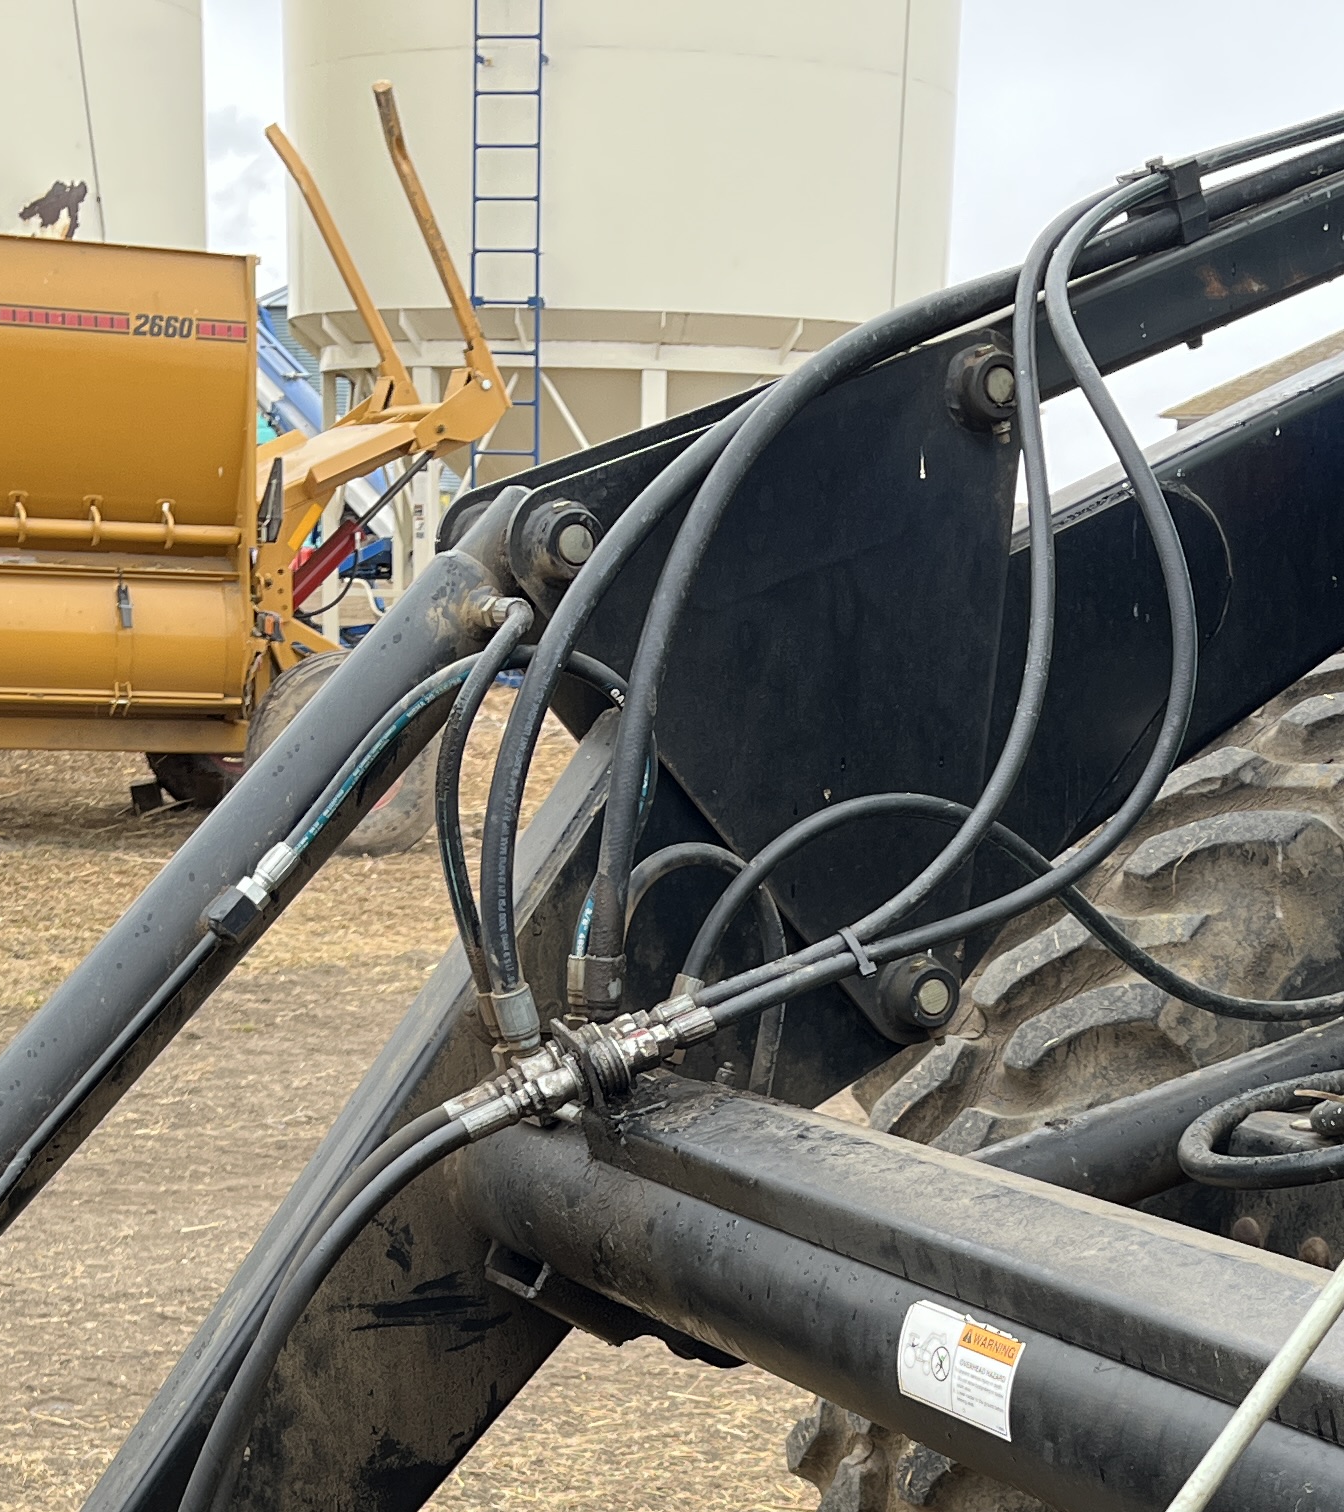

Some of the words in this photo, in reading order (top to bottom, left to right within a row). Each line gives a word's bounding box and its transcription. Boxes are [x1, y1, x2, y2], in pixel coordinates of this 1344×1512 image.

[133, 313, 193, 339] 2660
[500, 837, 509, 854] MAX
[498, 898, 506, 911] PSI
[973, 1333, 1016, 1359] WARNING
